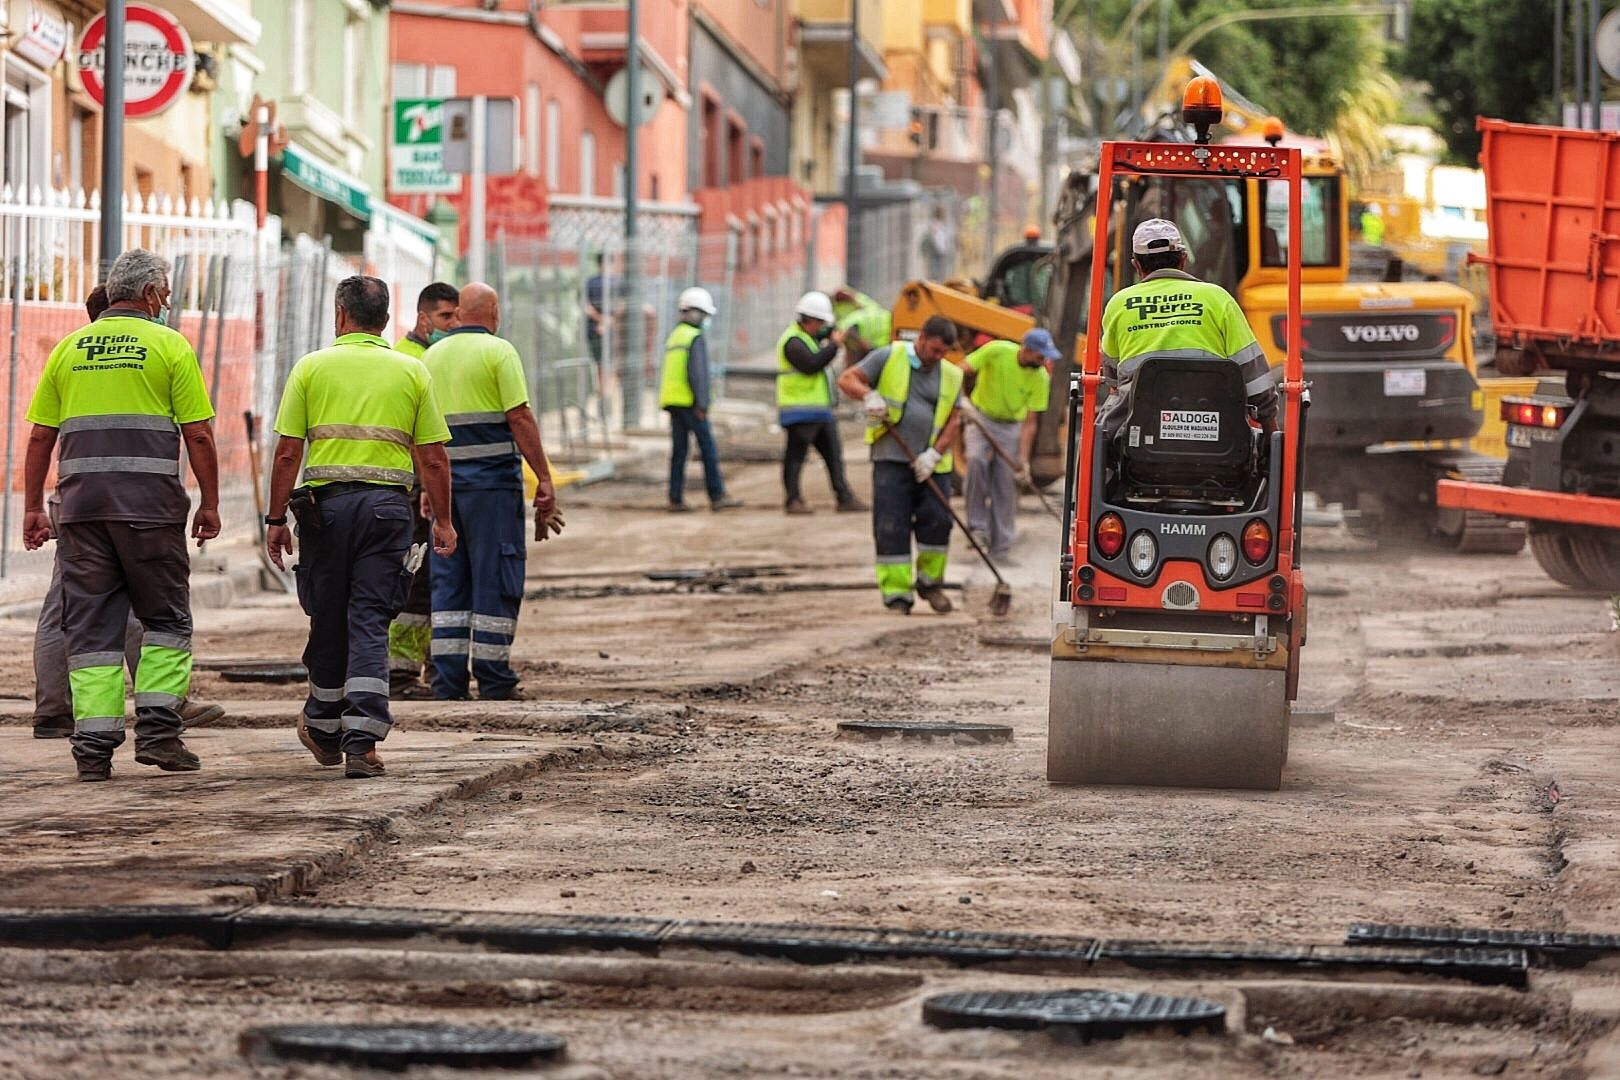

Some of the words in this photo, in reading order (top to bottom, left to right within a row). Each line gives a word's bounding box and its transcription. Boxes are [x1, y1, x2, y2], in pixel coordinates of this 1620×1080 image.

[1127, 320, 1202, 332] CONSTRUCCIONES
[1341, 324, 1419, 342] VOLVO
[72, 363, 144, 371] CONSTRUCCIONES
[1172, 413, 1218, 423] ALDOGA
[1160, 523, 1206, 535] HAMM
